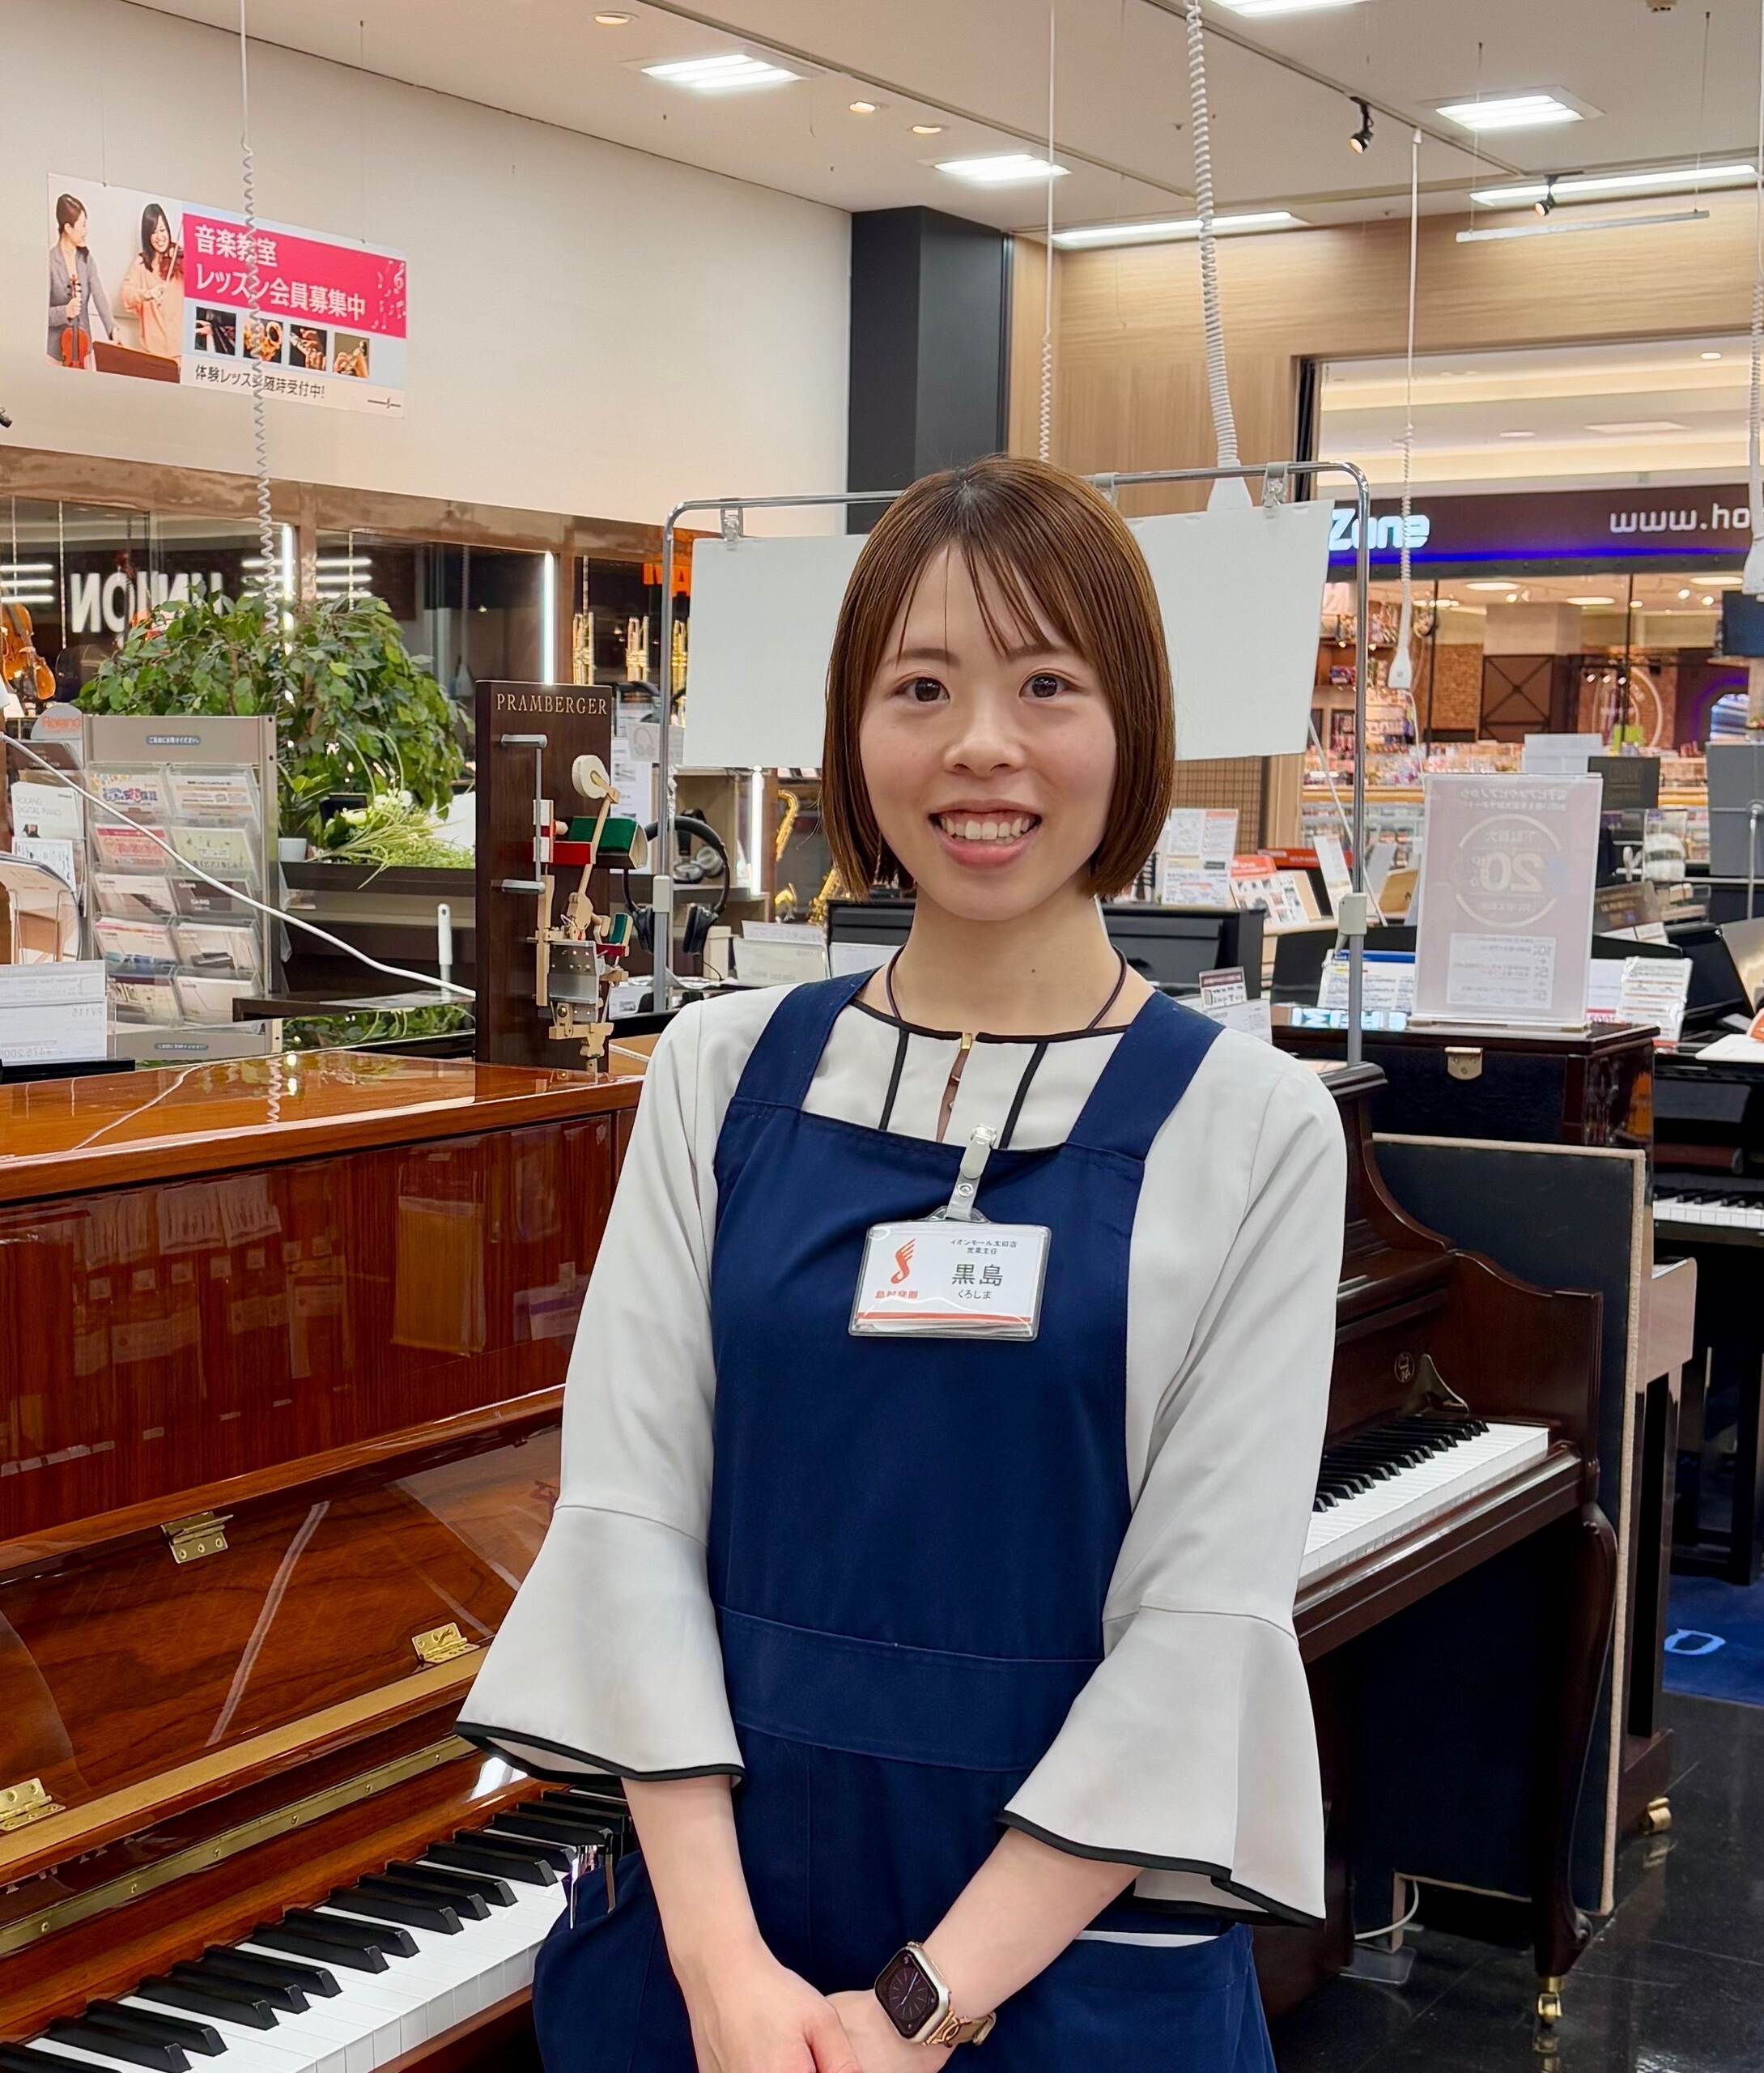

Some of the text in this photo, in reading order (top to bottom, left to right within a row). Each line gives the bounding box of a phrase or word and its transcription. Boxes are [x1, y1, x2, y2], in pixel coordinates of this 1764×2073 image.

[194, 224, 278, 267] 音楽教室
[196, 263, 365, 321] レッスン会員募集中
[496, 693, 607, 715] PRAMBERGER
[951, 1263, 1004, 1286] 黒島
[958, 1289, 993, 1300] くろしま
